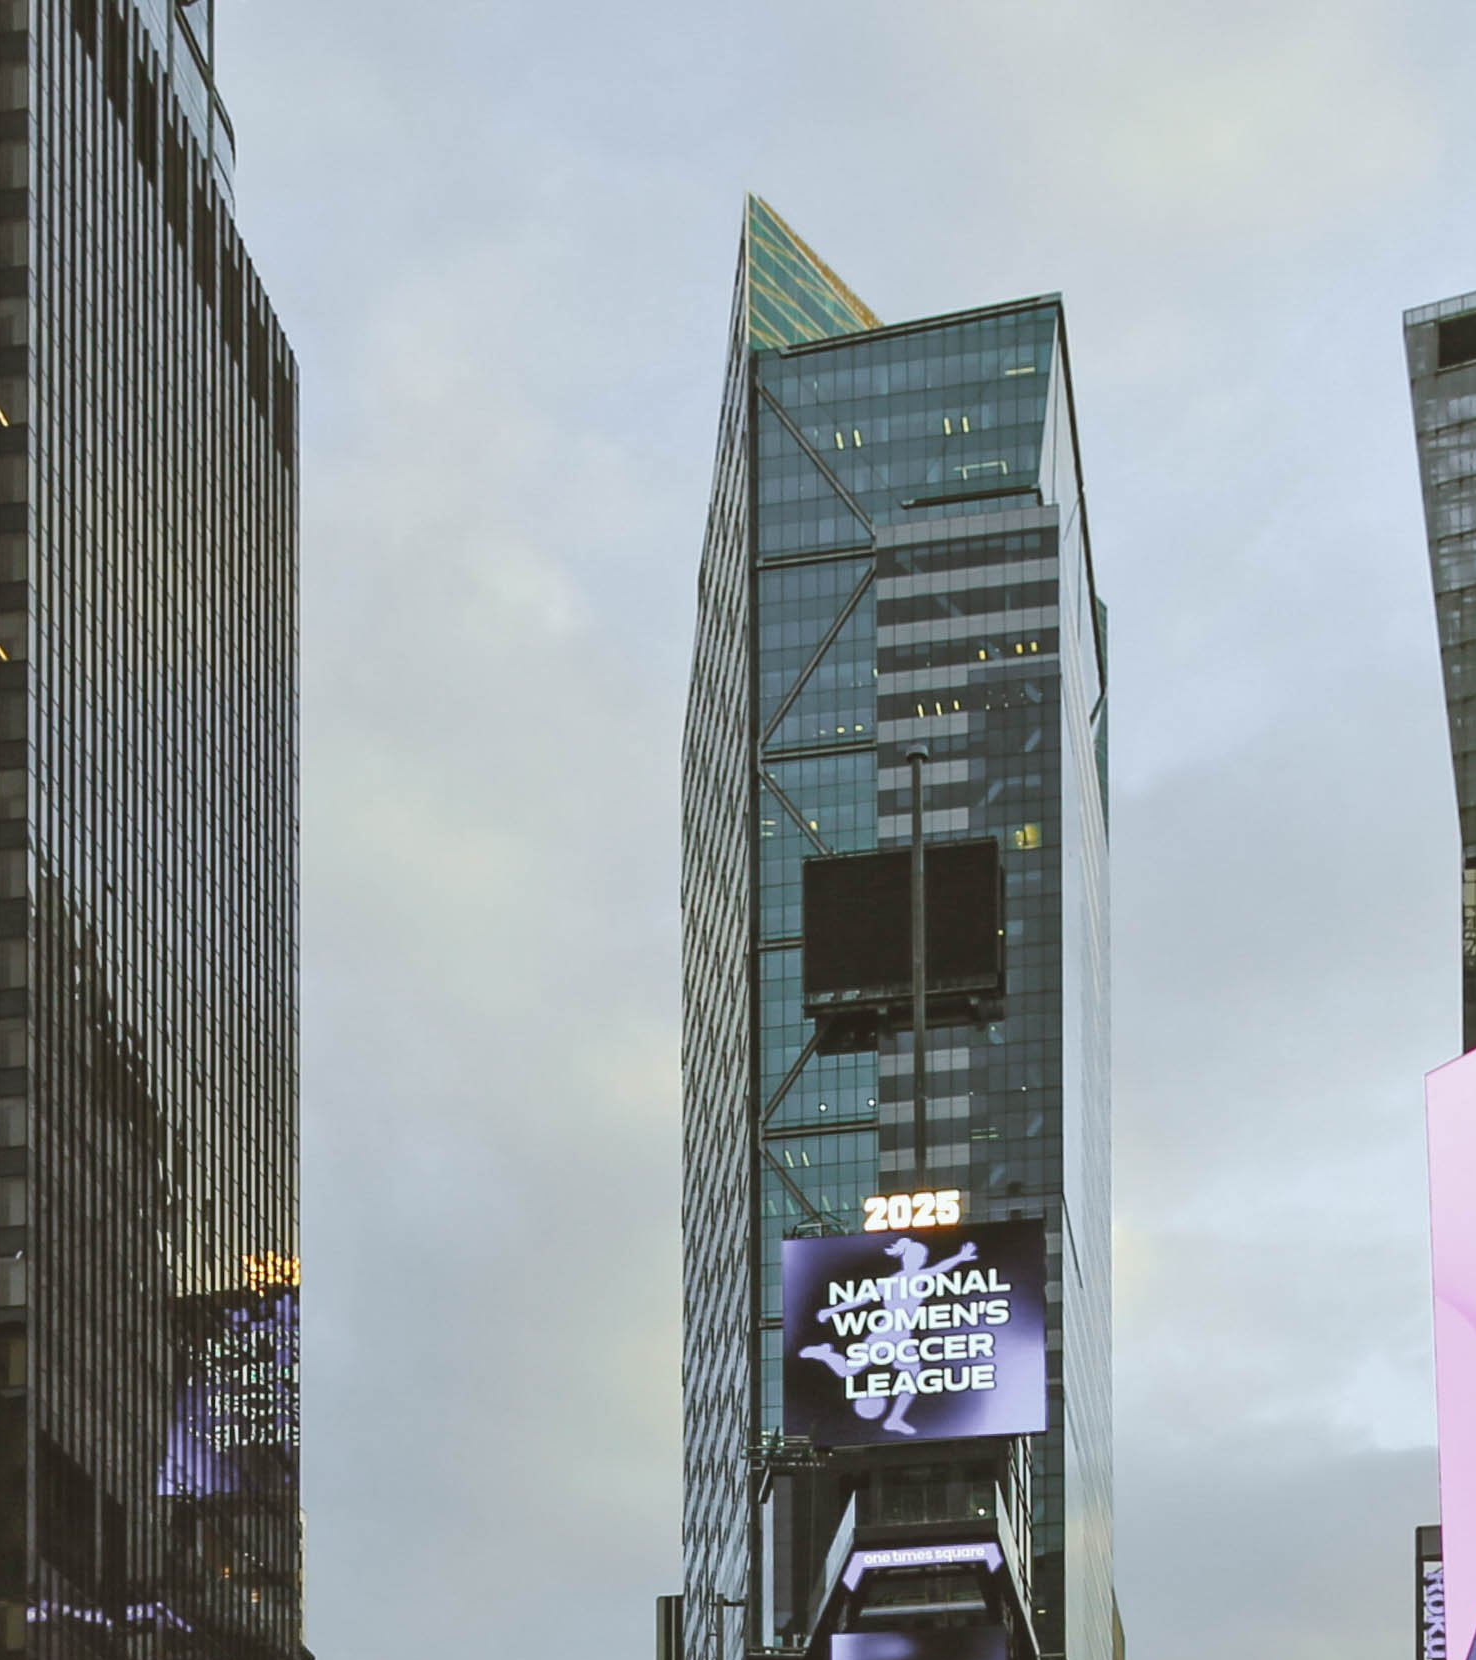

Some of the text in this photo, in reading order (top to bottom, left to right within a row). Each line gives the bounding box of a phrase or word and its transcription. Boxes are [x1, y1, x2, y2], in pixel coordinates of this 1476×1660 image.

[863, 1190, 961, 1232] 2025
[829, 1268, 1011, 1306] NATIONAL
[832, 1300, 1011, 1337] WOMEN'S
[845, 1332, 994, 1368] SOCCER
[845, 1364, 996, 1400] LEAGUE
[863, 1547, 985, 1565] one times square
